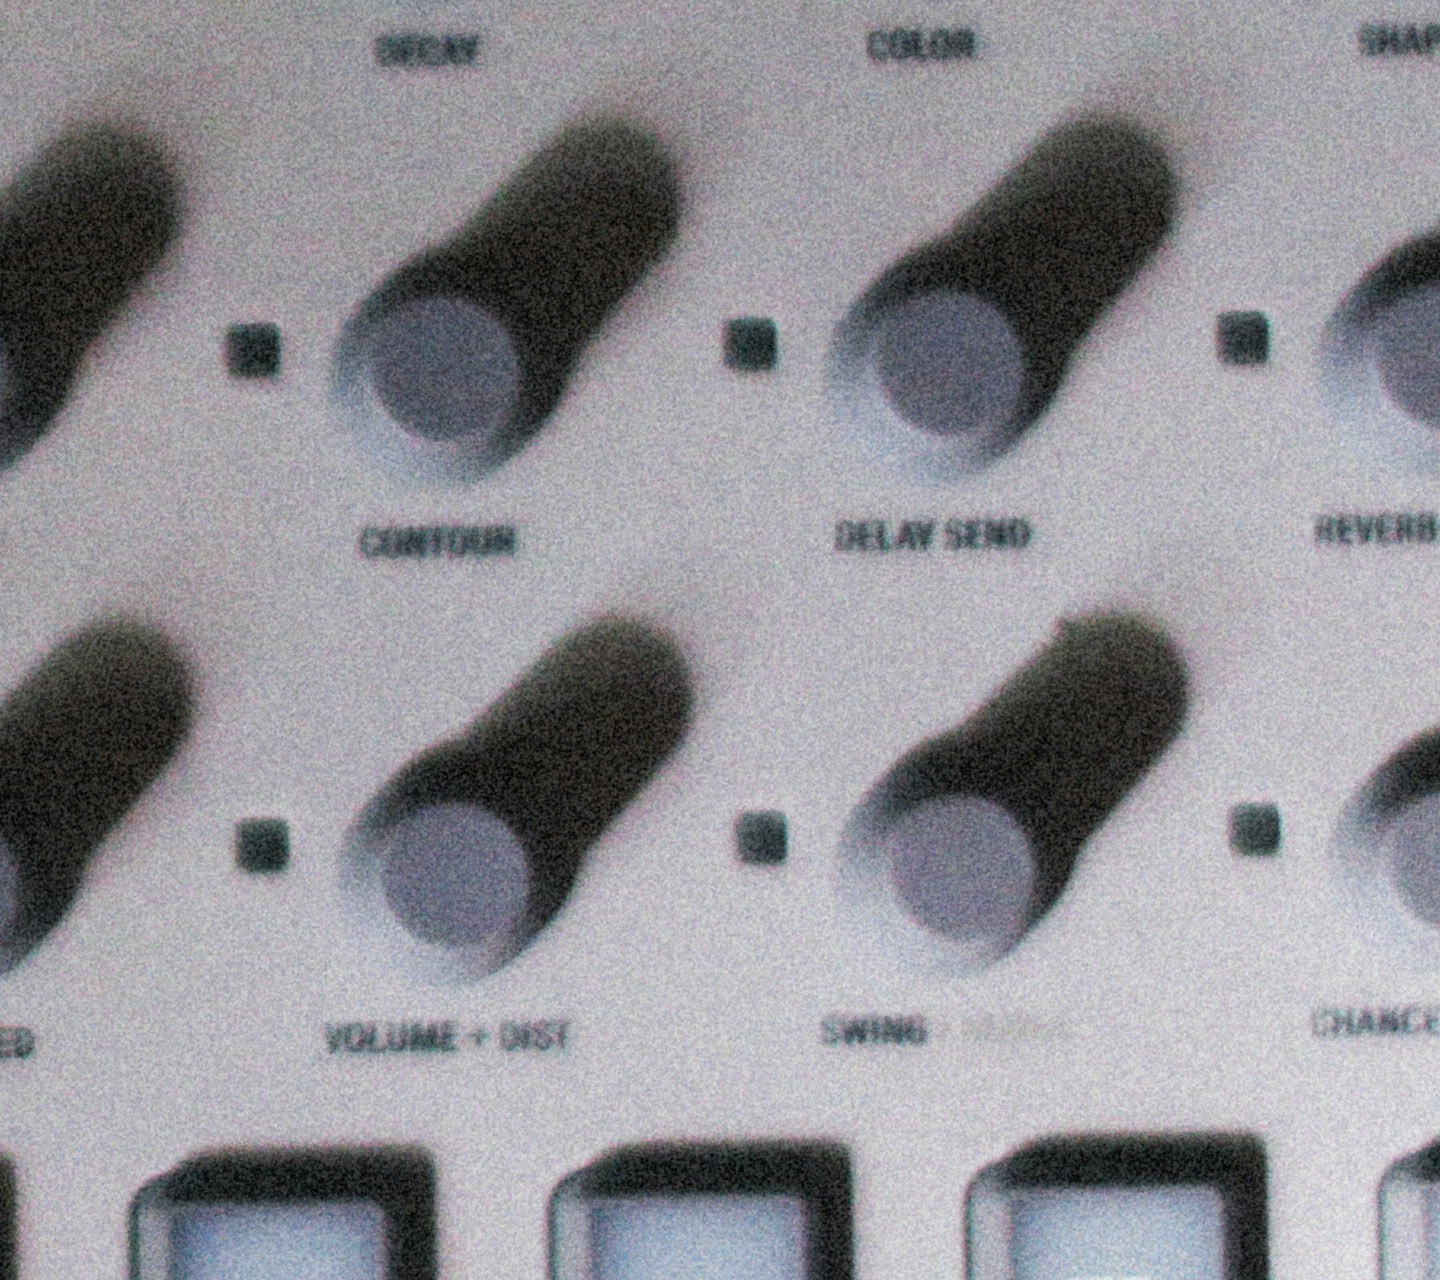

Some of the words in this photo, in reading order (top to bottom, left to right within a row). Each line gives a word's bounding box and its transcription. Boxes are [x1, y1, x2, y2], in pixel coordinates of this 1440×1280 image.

[376, 32, 480, 68] DECAY
[867, 27, 977, 62] COLOR
[360, 525, 517, 559] CONTOUR
[836, 520, 933, 553] DELAY
[945, 518, 1033, 550] SEND
[1315, 513, 1435, 545] REVERB
[328, 1023, 455, 1054] VOLUME
[499, 1020, 569, 1053] DIST
[821, 1017, 928, 1046] SWING
[1312, 1008, 1439, 1038] CHANCE
